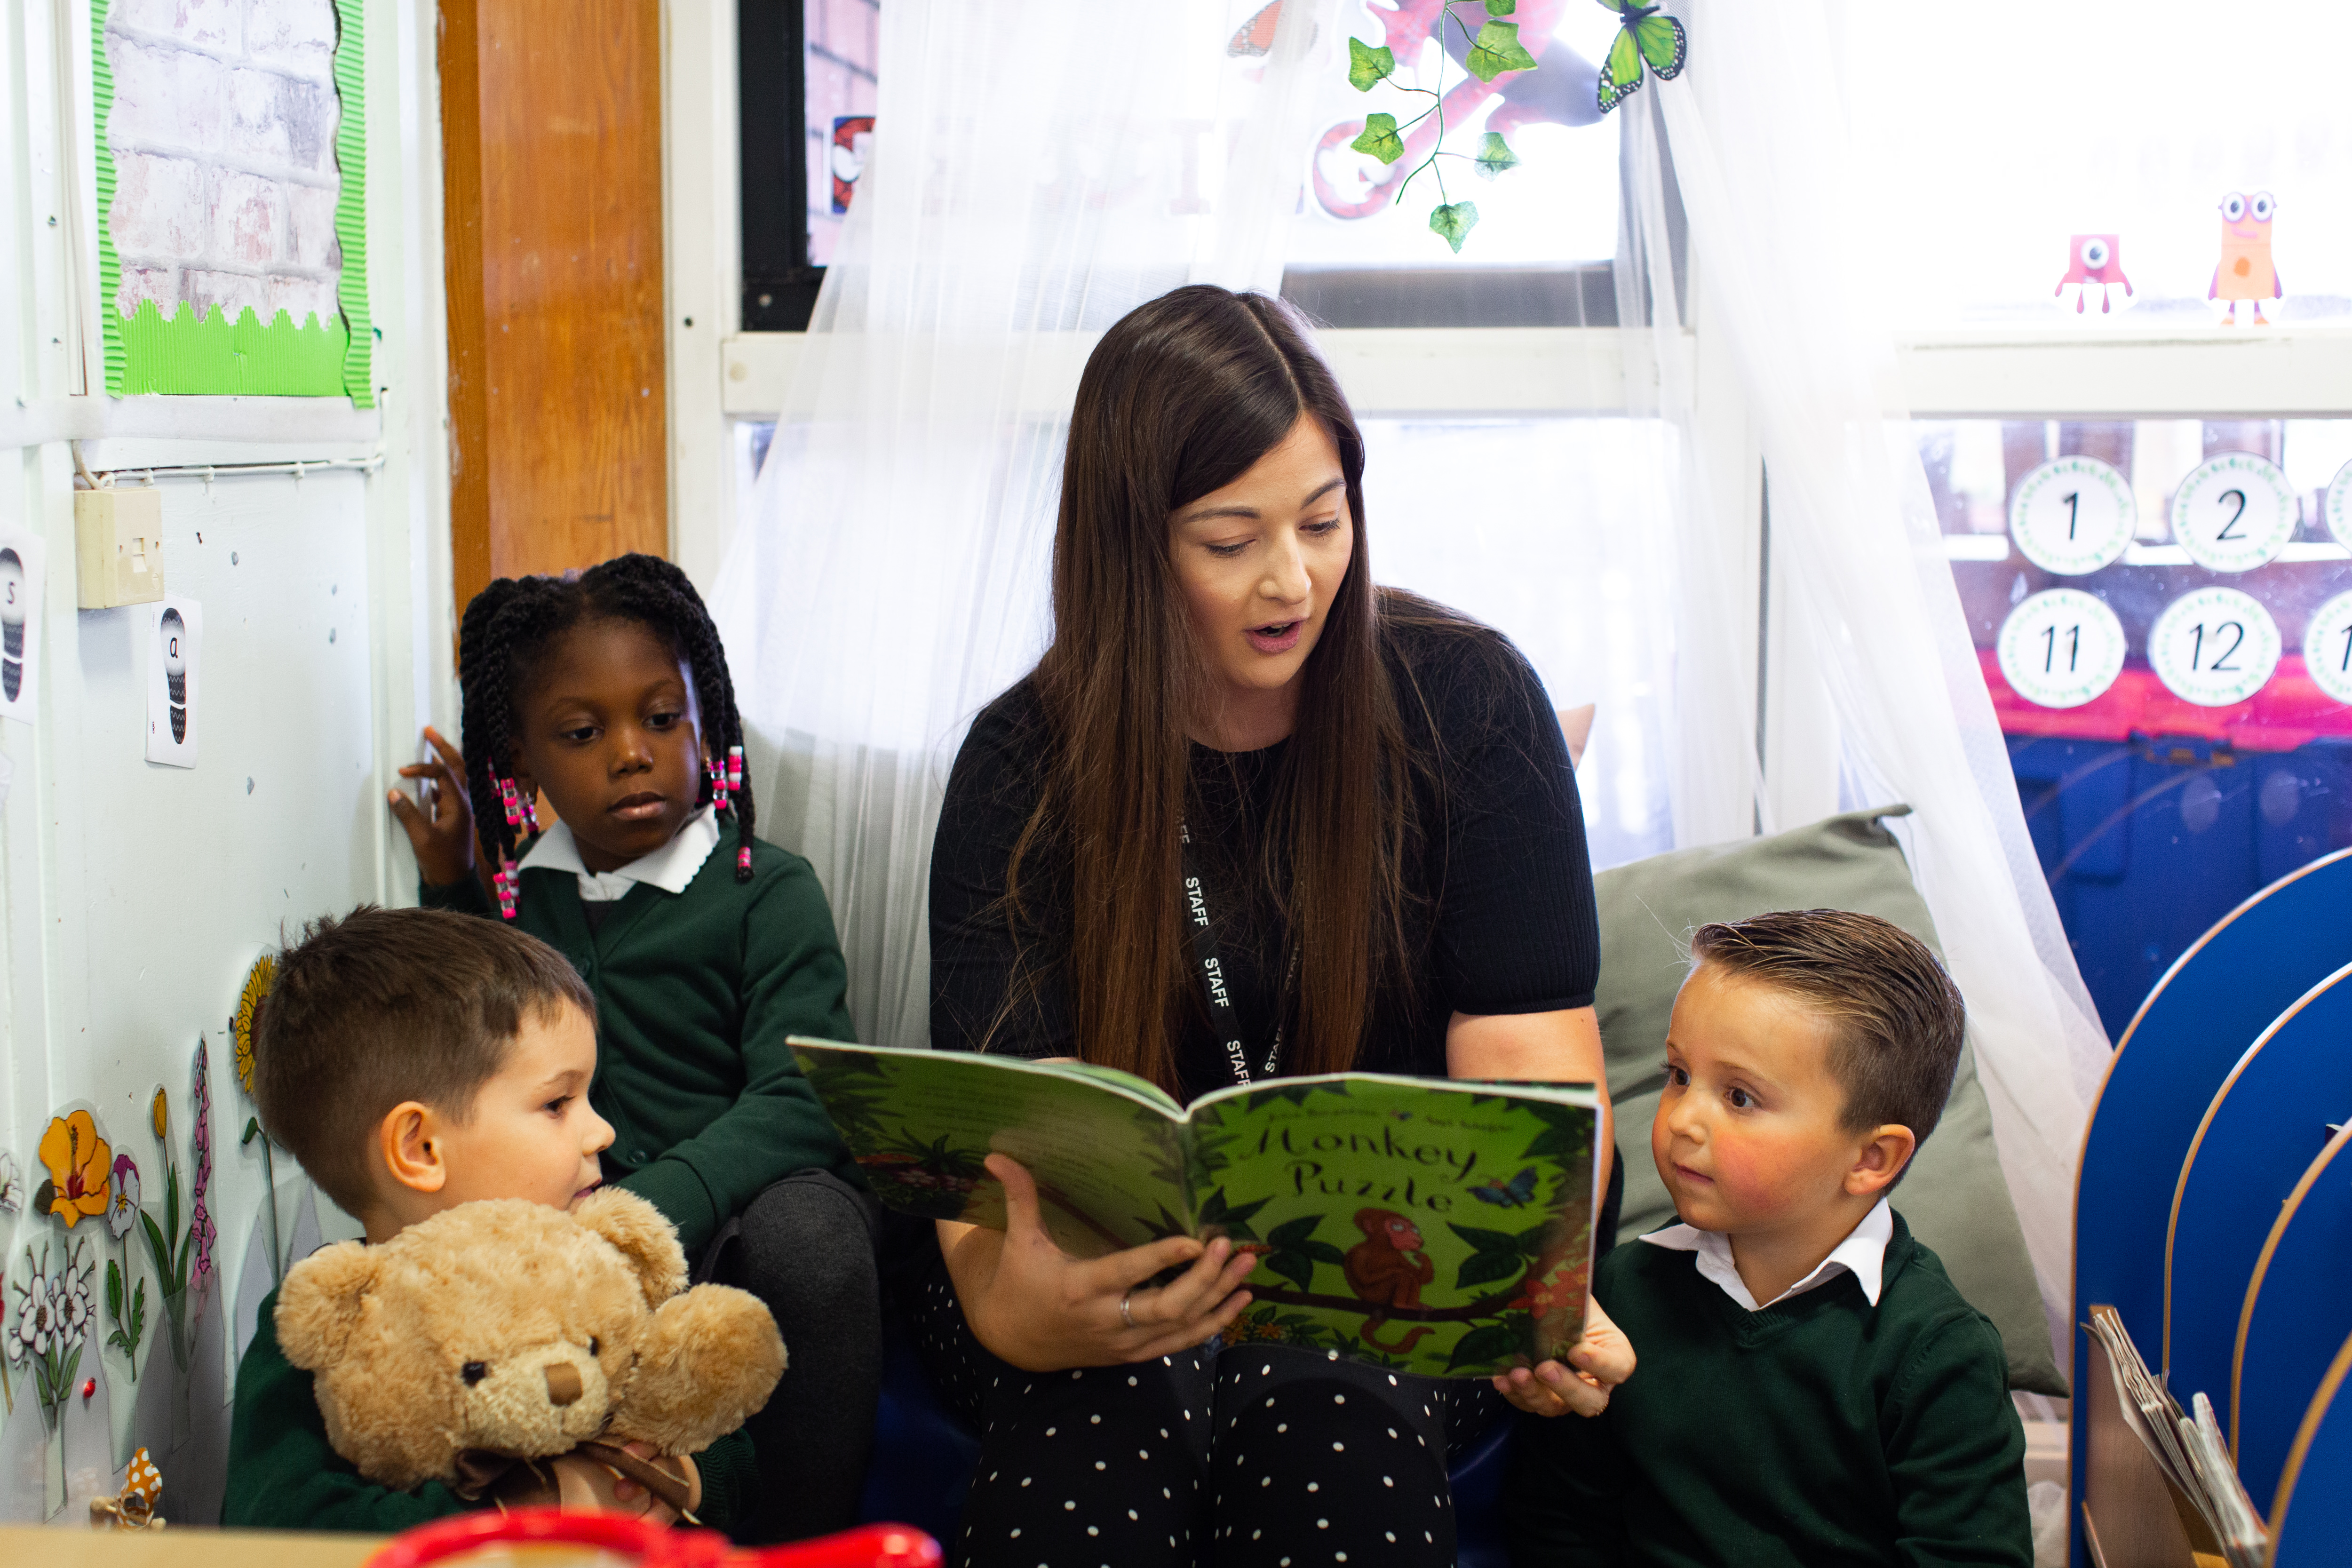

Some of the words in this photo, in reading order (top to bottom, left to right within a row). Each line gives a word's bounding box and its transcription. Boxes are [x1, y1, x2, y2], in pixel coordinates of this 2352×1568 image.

[2063, 492, 2078, 540] 1
[2217, 489, 2247, 541] 2
[170, 637, 178, 659] a
[2041, 624, 2080, 673] 11
[2189, 621, 2244, 671] 12
[1186, 877, 1209, 926] STAFF
[1205, 957, 1229, 1007] STAFF
[1265, 1027, 1282, 1073] STAF
[1239, 1125, 1477, 1183] Monkey
[1285, 1160, 1452, 1212] Puzzle
